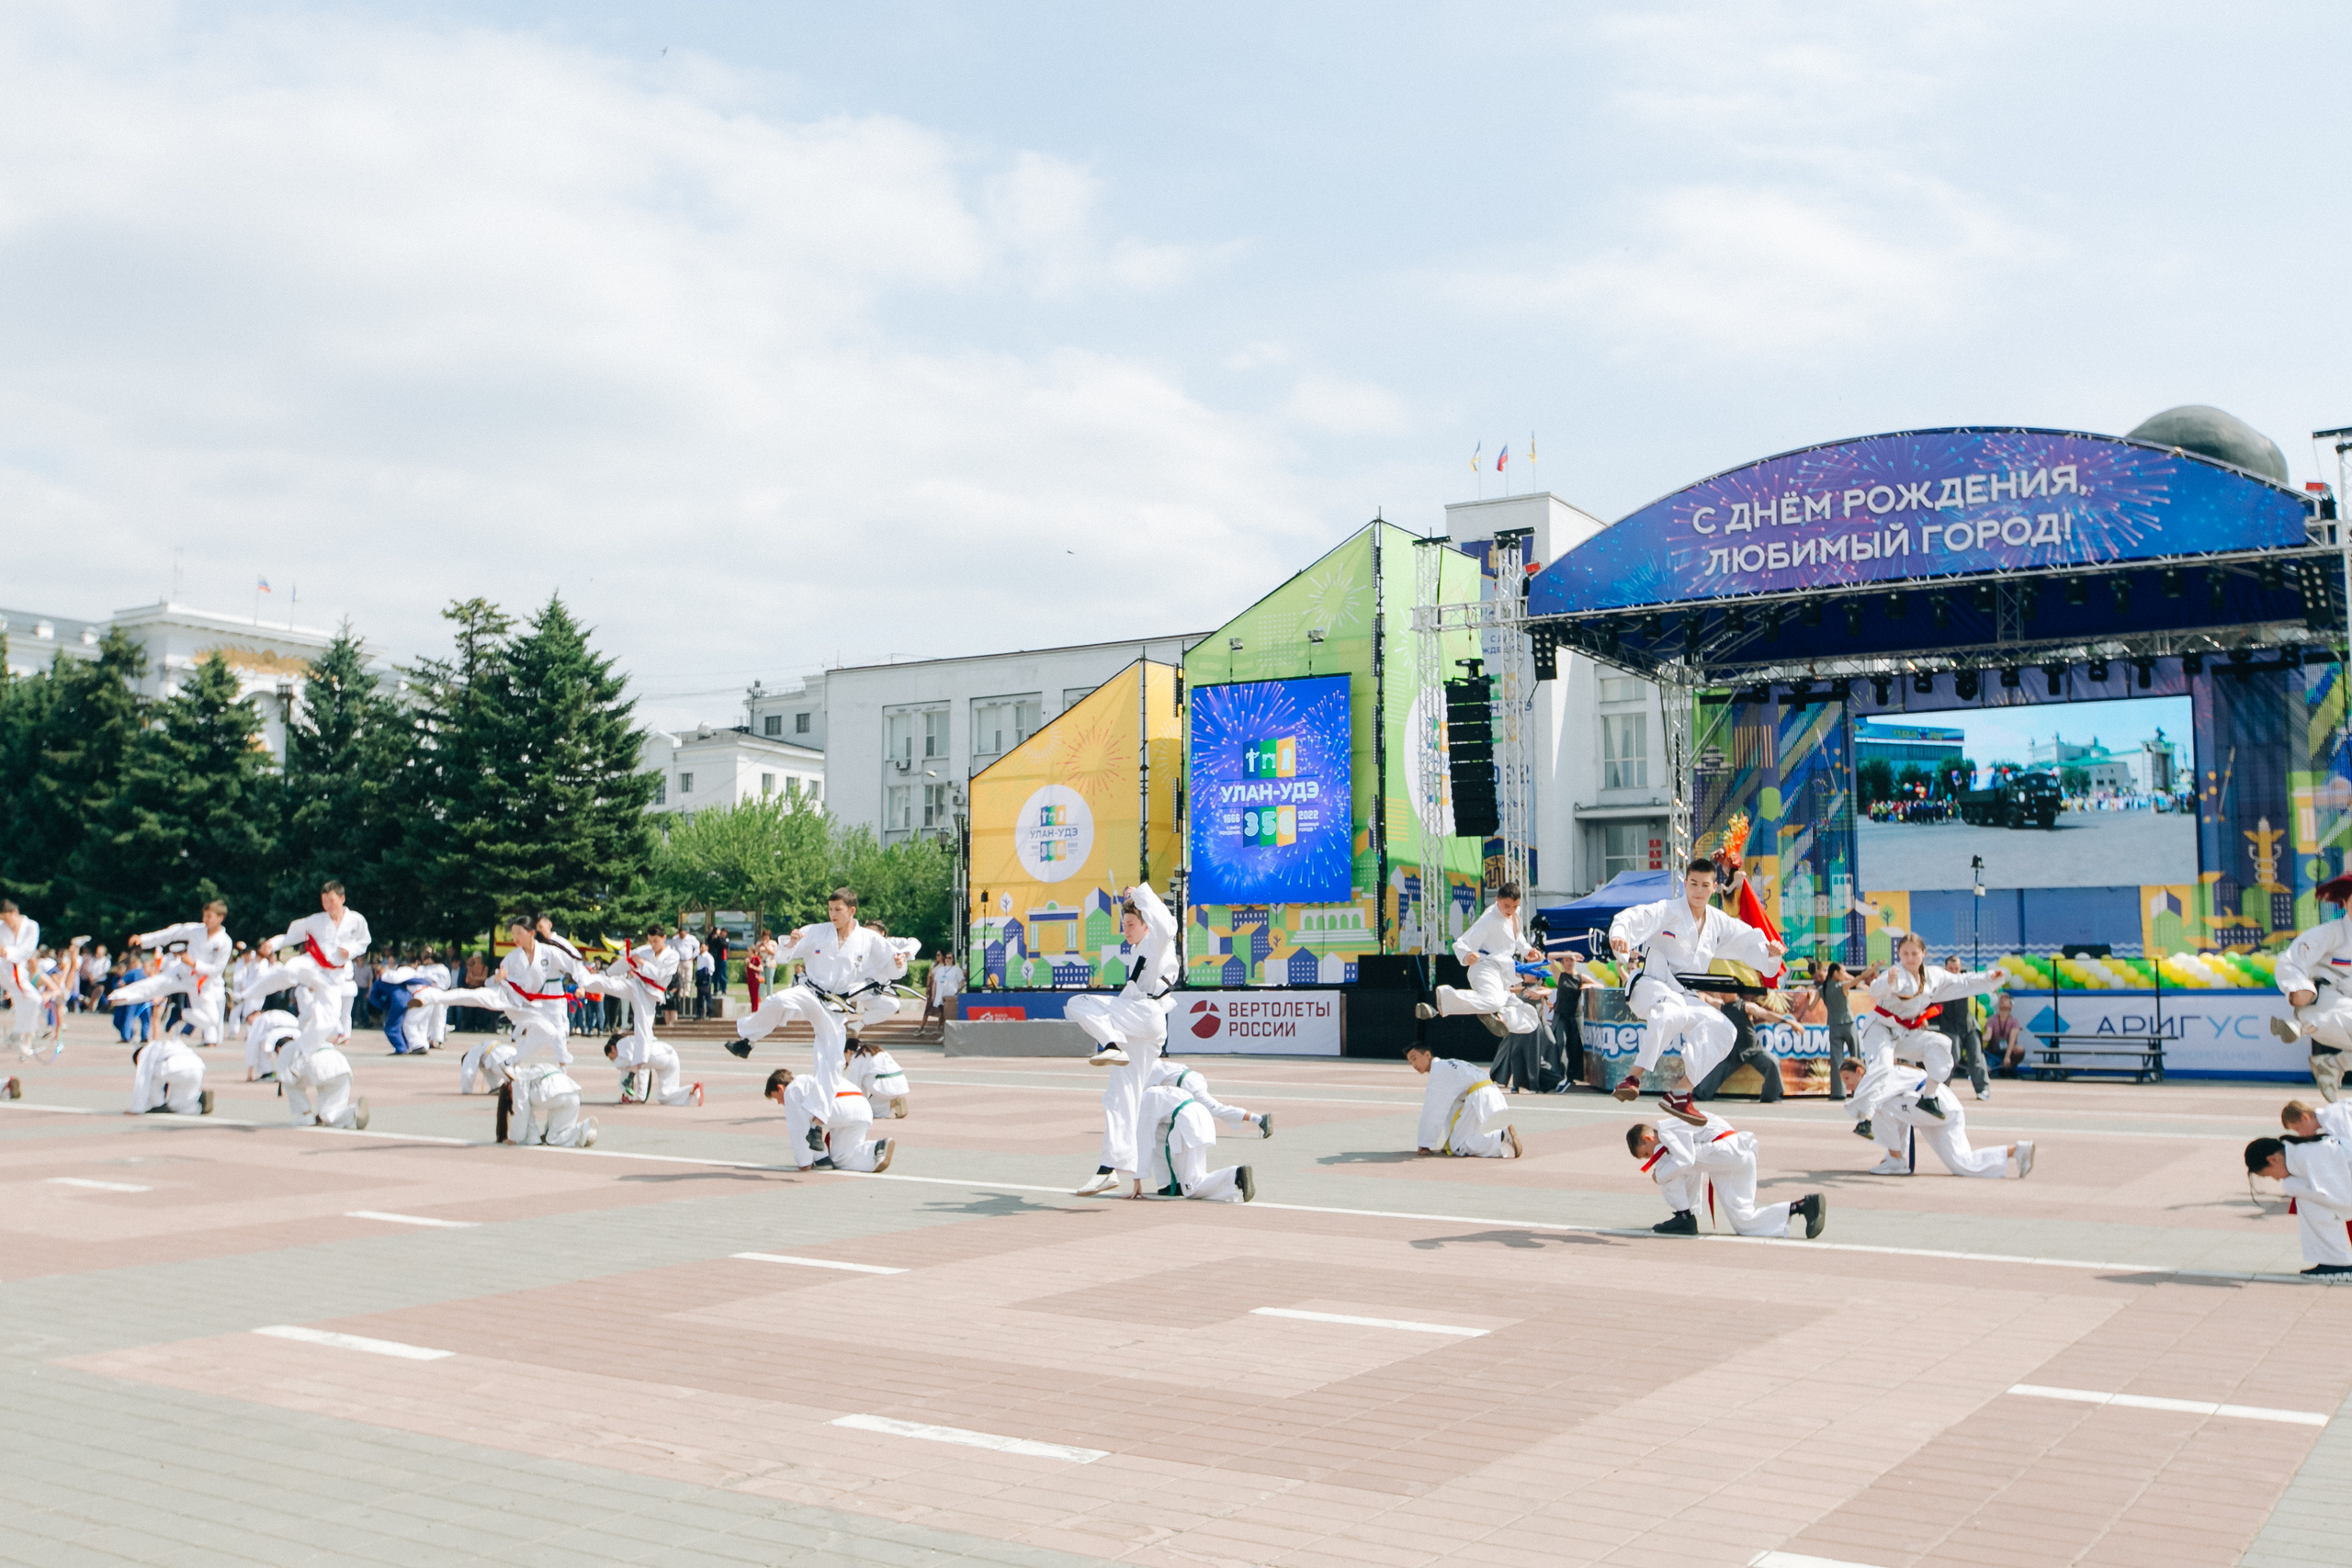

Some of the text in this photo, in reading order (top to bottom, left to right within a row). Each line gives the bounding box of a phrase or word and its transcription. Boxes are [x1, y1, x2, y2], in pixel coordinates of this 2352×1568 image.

[1692, 464, 2087, 535] С ДНЁМ РОЖДЕНИЯ,
[1704, 512, 2072, 577] ЛЮБИМЫЙ ГОРОД!
[1220, 781, 1319, 803] УЛАН-УДЭ
[1030, 828, 1079, 840] УЛАН-УДЭ
[1244, 810, 1295, 837] 356
[1297, 809, 1319, 820] 2022
[1229, 1001, 1329, 1017] ВЕРТОЛЕТЫ
[1229, 1021, 1295, 1037] РОССИИ
[2097, 1015, 2260, 1040] АРИГУС
